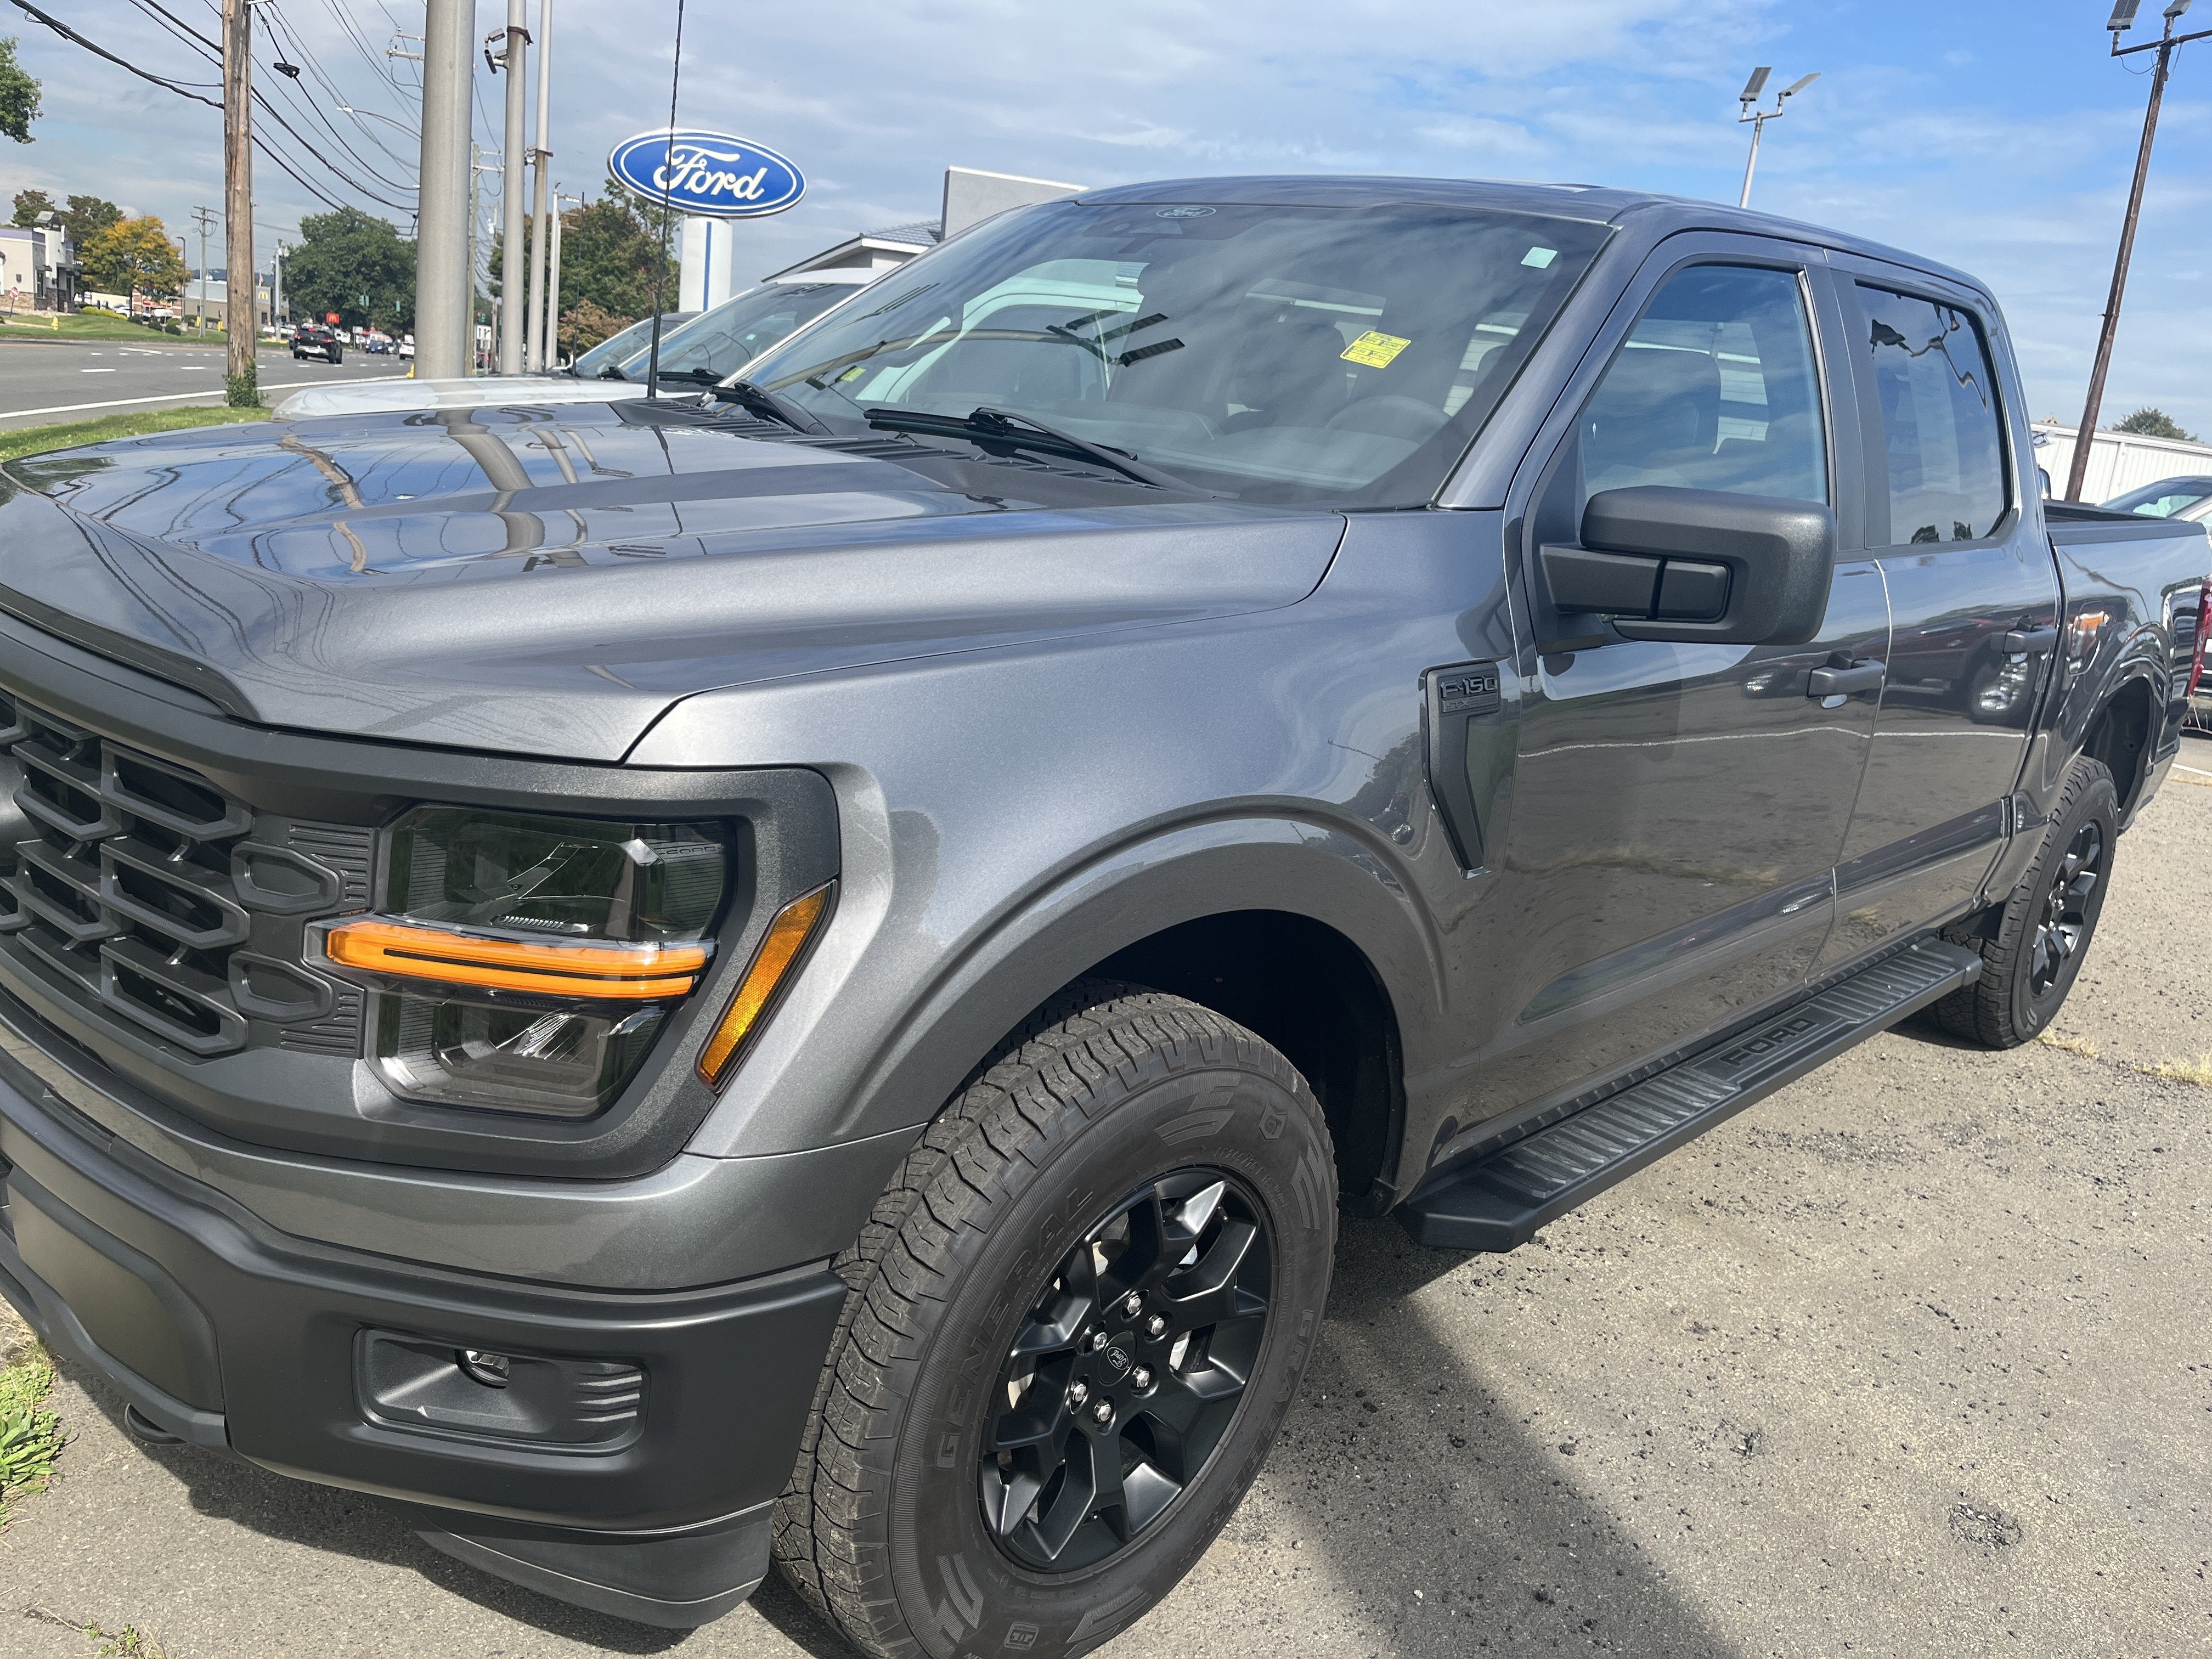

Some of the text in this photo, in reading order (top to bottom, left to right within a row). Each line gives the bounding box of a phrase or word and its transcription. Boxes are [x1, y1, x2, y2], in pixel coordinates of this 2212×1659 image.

[653, 145, 768, 200] Ford
[1164, 207, 1207, 216] Ford
[1441, 676, 1498, 698] F-150
[1446, 700, 1469, 710] STX
[1719, 1018, 1819, 1067] FORD
[936, 1188, 1094, 1470] GENERAL
[1110, 1350, 1127, 1368] Ford
[1207, 1309, 1315, 1534] GRABBER
